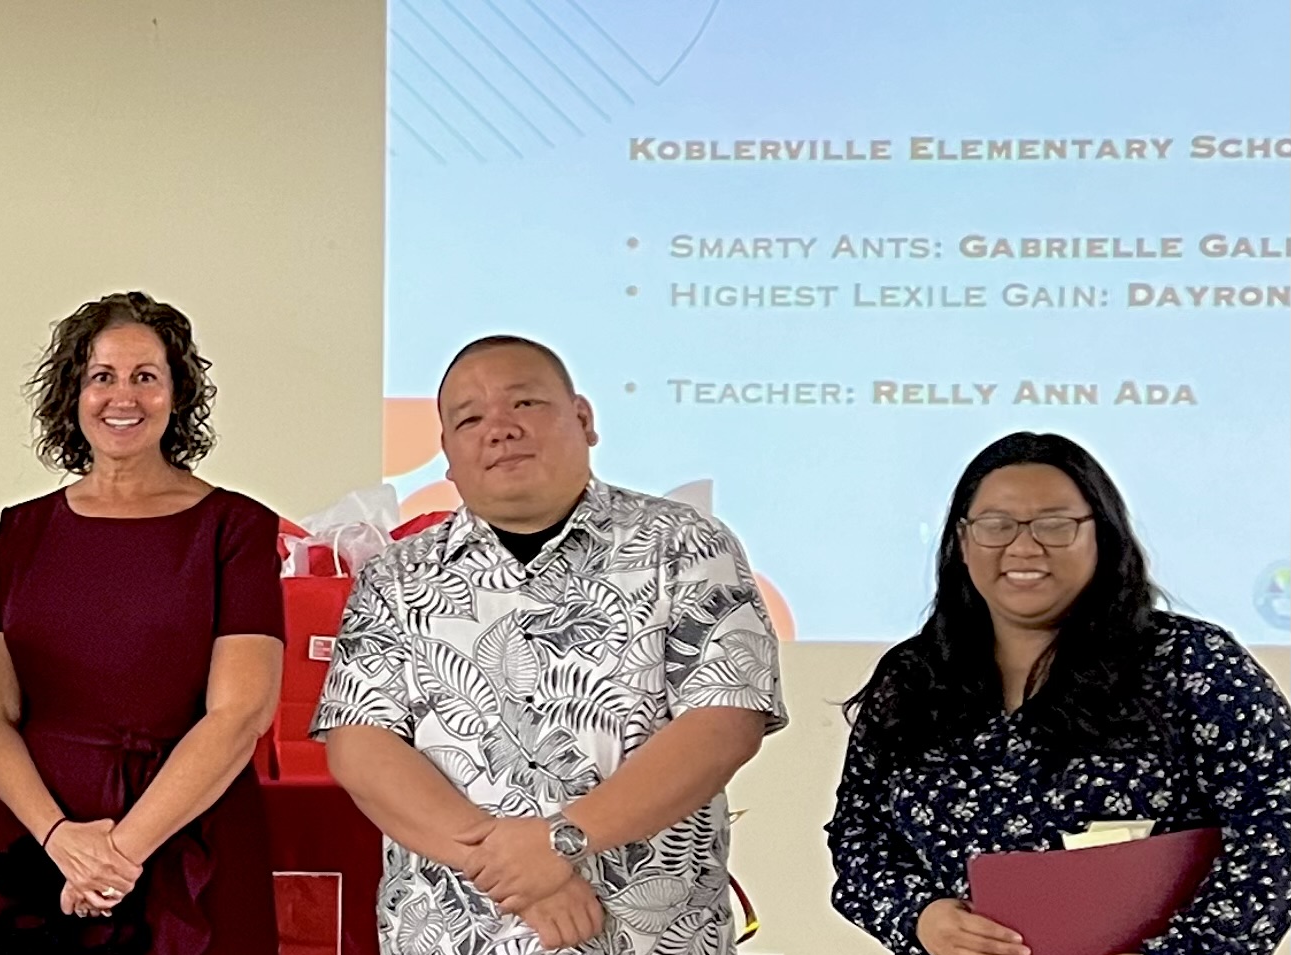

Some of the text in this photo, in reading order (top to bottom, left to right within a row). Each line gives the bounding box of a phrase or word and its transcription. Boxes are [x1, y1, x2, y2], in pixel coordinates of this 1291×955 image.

[629, 135, 893, 161] KOBLERVILLE
[909, 135, 1174, 161] ELEMENTARY
[669, 233, 818, 259] SMARTY
[830, 233, 944, 259] ANTS:
[958, 233, 1184, 259] GABRIELLE
[670, 281, 1291, 308] HIGHEST LEXILE GAIN: DAYRON
[666, 378, 1199, 406] TEACHER: RELLY ANN ADA
